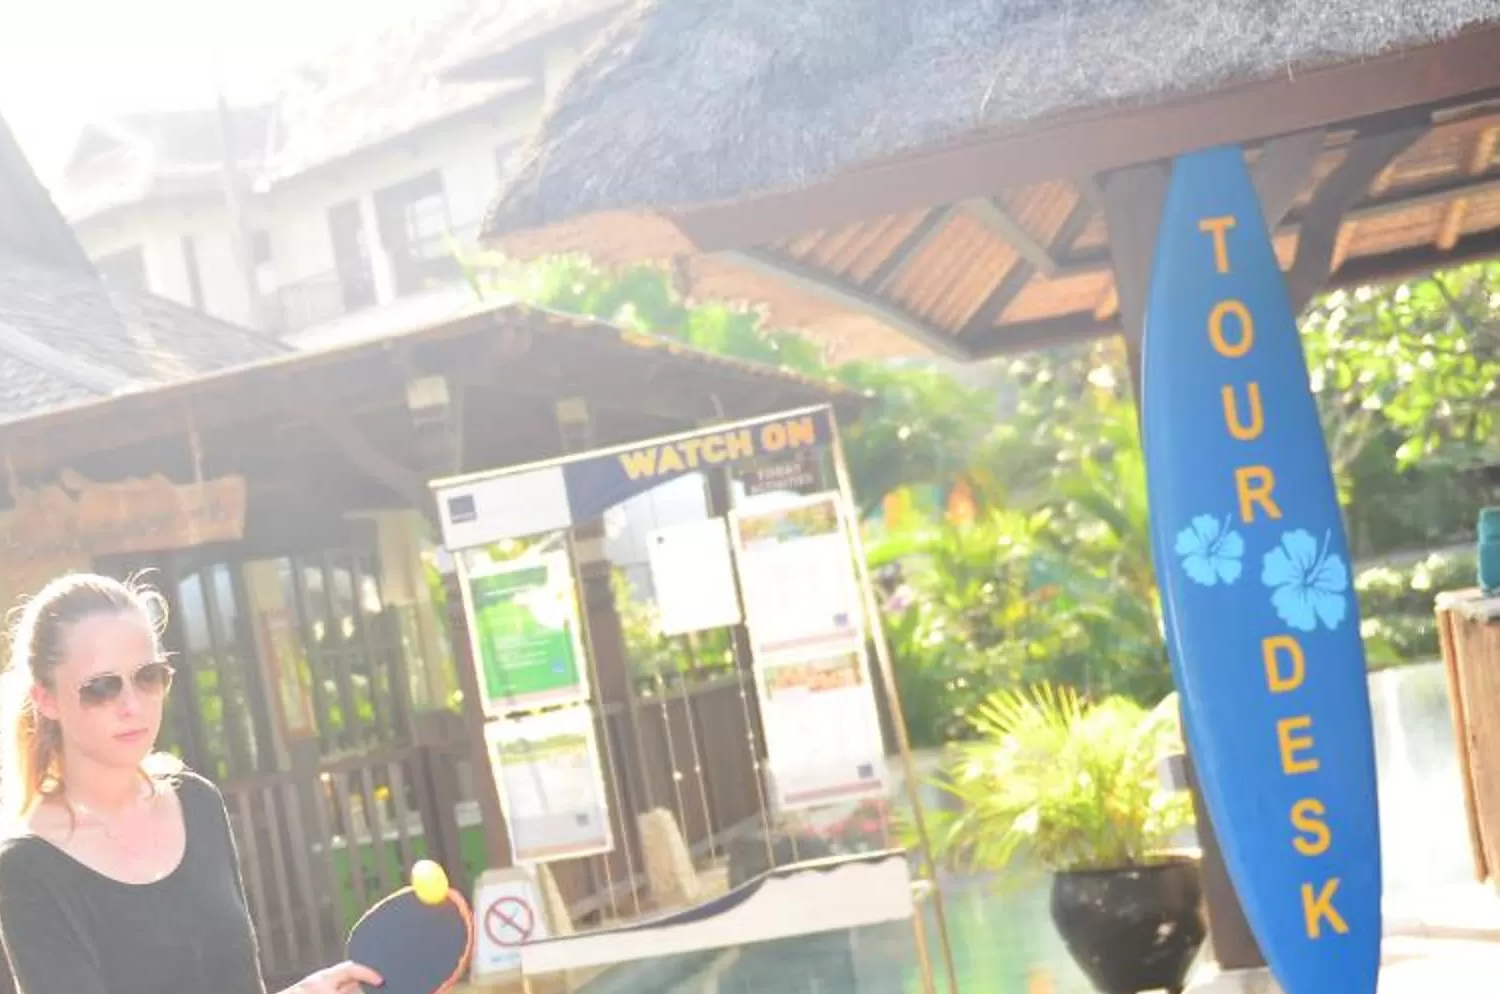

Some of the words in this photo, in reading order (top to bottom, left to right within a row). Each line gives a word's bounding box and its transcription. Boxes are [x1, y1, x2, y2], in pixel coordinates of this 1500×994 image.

[619, 430, 753, 480] WATCH
[761, 417, 814, 450] ON
[1199, 215, 1283, 524] TOUR
[1261, 634, 1349, 939] DESK
